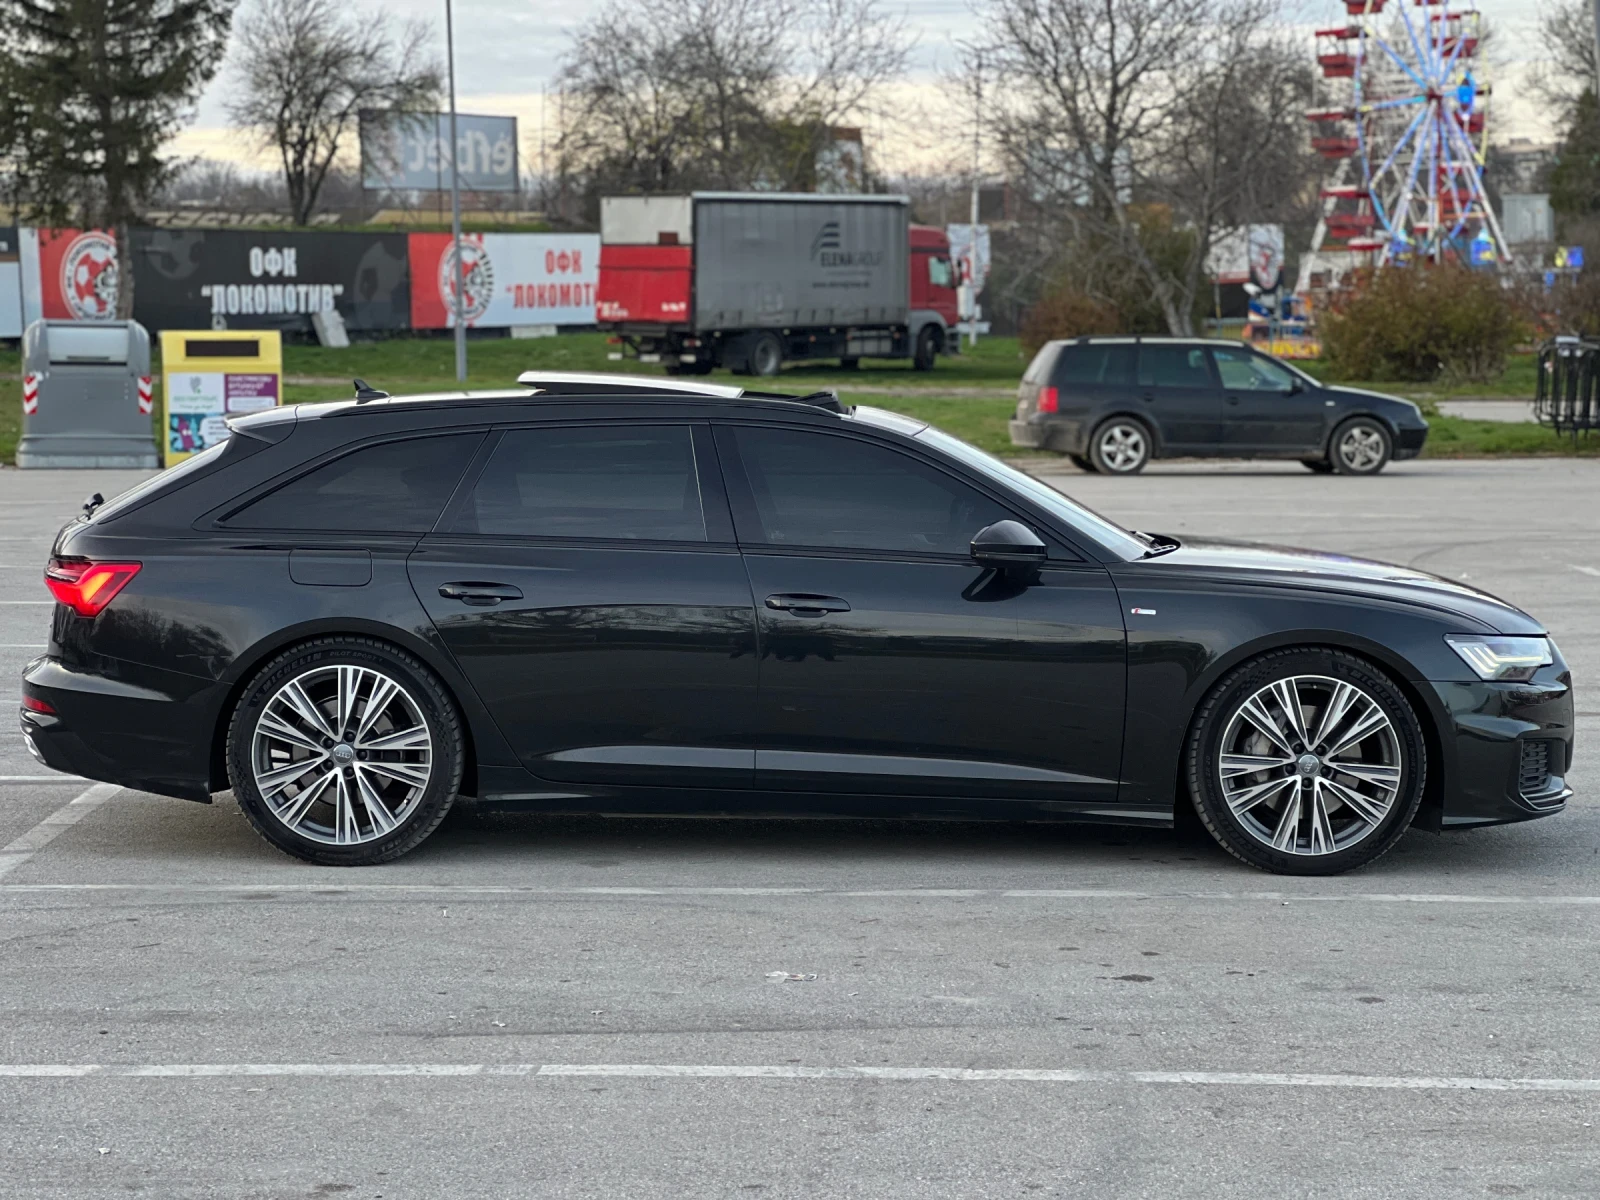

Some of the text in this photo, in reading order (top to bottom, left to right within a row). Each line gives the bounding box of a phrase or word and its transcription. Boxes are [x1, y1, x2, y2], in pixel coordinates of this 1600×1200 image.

[249, 246, 297, 277] ОФК
[544, 248, 582, 275] ОФК
[505, 282, 597, 310] “ЛОКОМОТ
